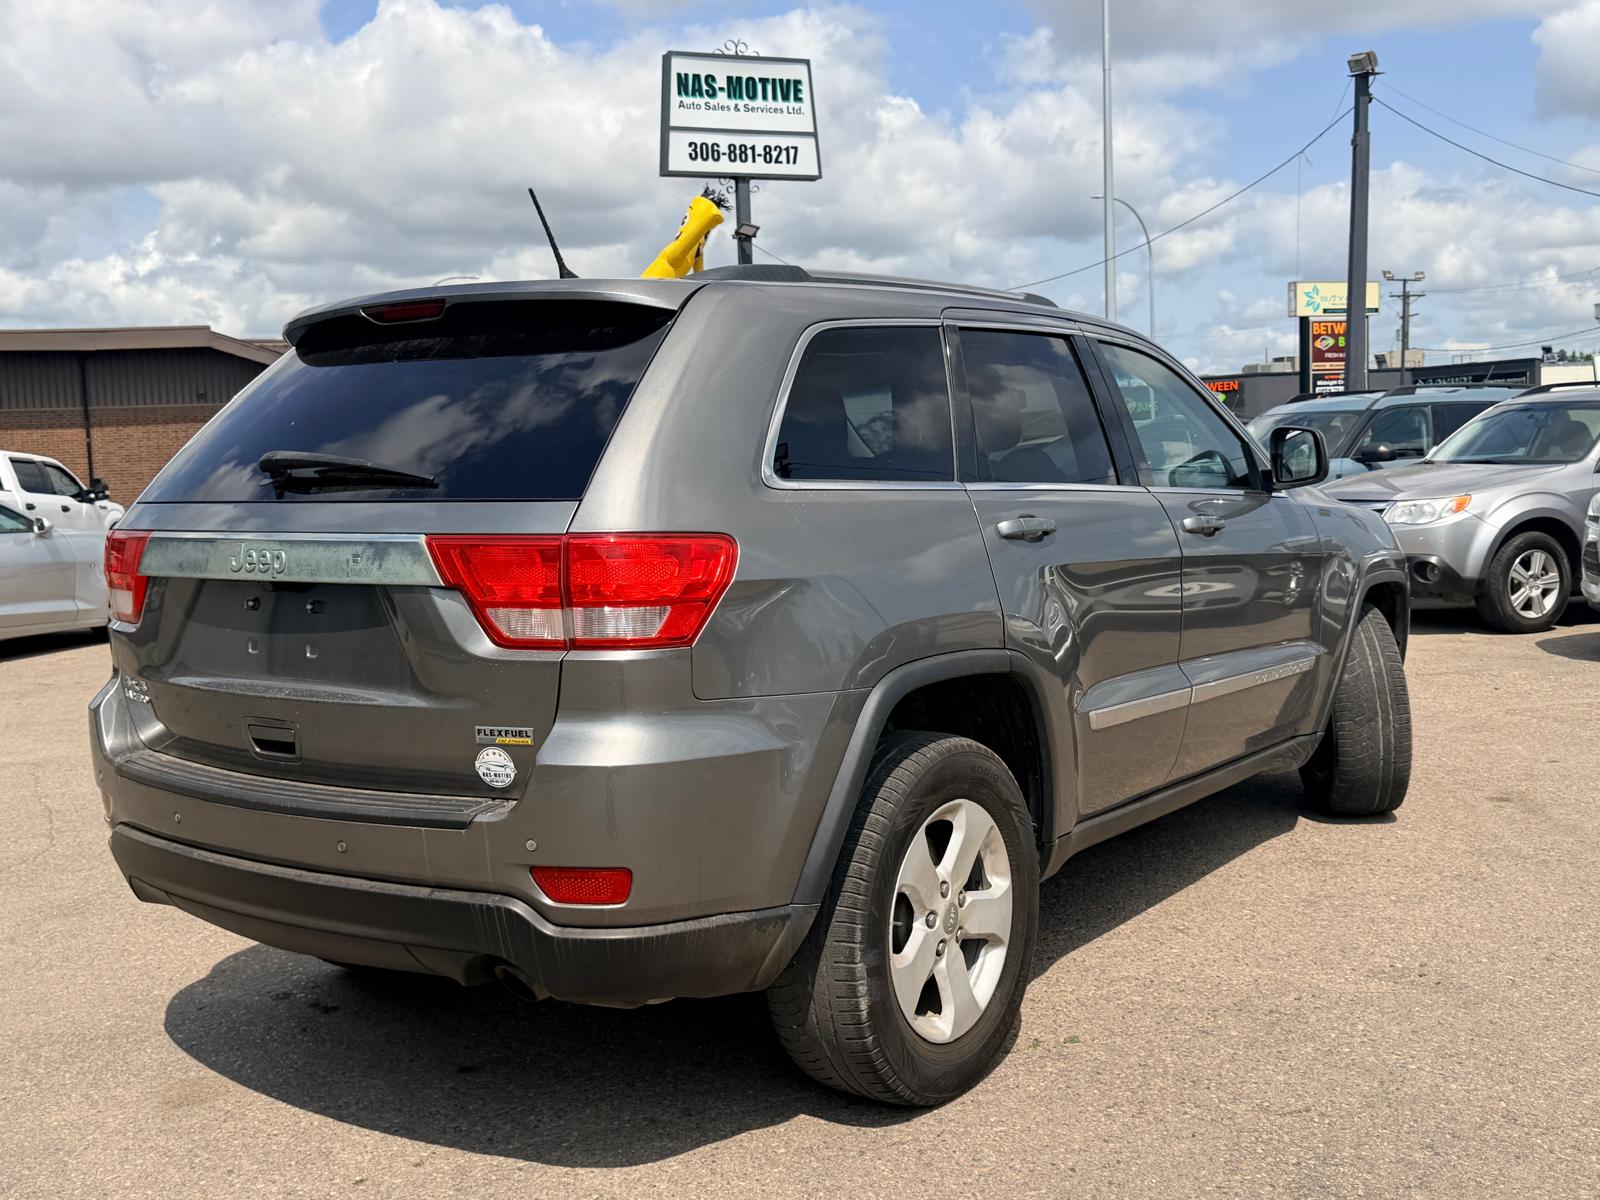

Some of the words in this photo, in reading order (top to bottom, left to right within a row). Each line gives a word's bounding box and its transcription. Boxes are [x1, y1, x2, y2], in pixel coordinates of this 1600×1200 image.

[676, 72, 804, 103] NAS-MOTIVE
[678, 100, 702, 111] Auto
[704, 102, 731, 112] Sales
[733, 104, 741, 112] &
[743, 104, 784, 114] Services
[786, 105, 805, 115] Ltd.
[688, 141, 799, 165] 306-881-8217
[1206, 380, 1239, 392] WEEN
[228, 541, 288, 579] Jeep
[477, 728, 531, 738] FLEXFUEL
